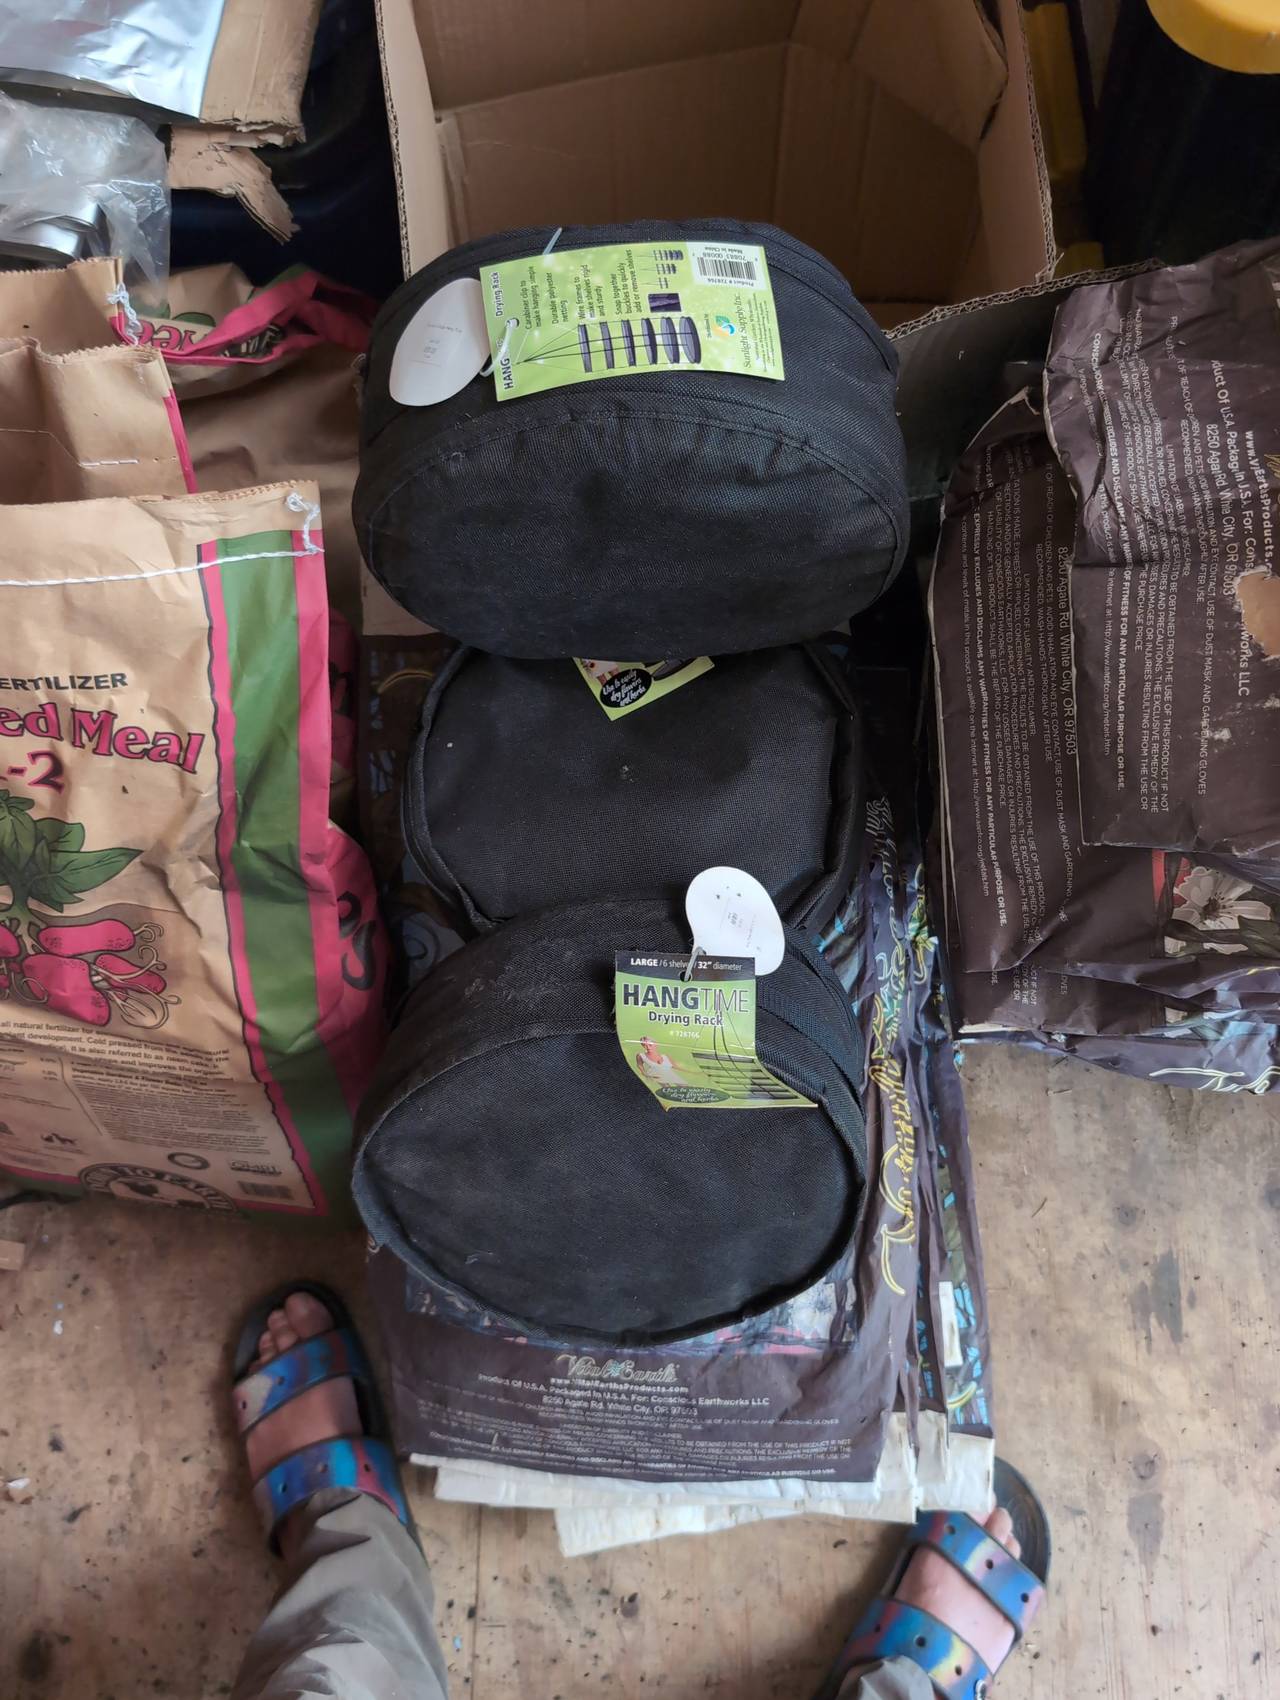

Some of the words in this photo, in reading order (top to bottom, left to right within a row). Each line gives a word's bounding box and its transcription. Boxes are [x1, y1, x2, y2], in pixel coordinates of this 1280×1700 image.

[491, 272, 500, 288] Rack
[546, 272, 556, 298] polyester
[584, 279, 593, 300] shelves
[610, 273, 620, 300] together
[494, 290, 504, 316] Drying
[521, 288, 530, 299] clip
[575, 284, 584, 304] frames
[623, 290, 632, 313] buckles
[523, 300, 532, 329] Carabiner
[550, 299, 560, 324] Durable
[560, 300, 569, 322] netting
[577, 305, 586, 320] Wire
[588, 300, 596, 318] make
[614, 301, 622, 315] Snap
[634, 302, 642, 312] add
[740, 335, 752, 368] Sunlight
[1206, 424, 1219, 448] 8250
[1207, 450, 1222, 473] Agat
[1222, 516, 1235, 541] City,
[1242, 510, 1254, 534] For:
[1226, 544, 1239, 562] OR
[974, 556, 982, 596] EXCLUDES
[1124, 570, 1131, 581] OF
[1056, 577, 1069, 608] Agate
[1170, 582, 1178, 593] BE
[1120, 582, 1130, 616] FITNESS
[1158, 592, 1166, 610] AND
[1206, 600, 1215, 616] USE
[1167, 594, 1177, 636] OBTAINED
[1206, 618, 1214, 630] OF
[976, 617, 984, 658] DISCLAIMS
[1120, 618, 1128, 636] FOR
[1060, 634, 1072, 666] White
[1166, 639, 1175, 663] FROM
[1205, 632, 1213, 655] DUST
[1165, 666, 1174, 682] THE
[1203, 657, 1212, 682] MASK
[1060, 670, 1072, 694] City,
[1117, 658, 1126, 712] PARTICULAR
[1154, 676, 1162, 693] THE
[1238, 672, 1250, 696] LLC
[978, 678, 988, 728] WARRANTIES
[1164, 685, 1172, 702] USE
[1202, 684, 1211, 703] AND
[1063, 698, 1073, 716] OR
[1152, 694, 1161, 741] EXCLUSIVE
[1163, 704, 1172, 716] OF
[982, 730, 989, 742] OF
[1064, 720, 1076, 755] 97503
[1116, 713, 1125, 754] PURPOSE
[1162, 718, 1171, 737] THIS
[70, 708, 205, 775] Meal
[983, 743, 991, 775] FITNESS
[1117, 756, 1124, 769] OR
[1150, 743, 1159, 779] REMEDY
[1161, 739, 1170, 781] PRODUCT
[1150, 781, 1158, 793] OF
[1161, 782, 1169, 792] IF
[1198, 760, 1207, 795] GLOVES
[1150, 796, 1158, 813] THE
[1160, 794, 1169, 812] NOT
[988, 812, 997, 860] PARTICULAR
[998, 897, 1005, 908] OR
[630, 958, 658, 967] LARGE
[663, 959, 668, 967] 6
[713, 962, 742, 971] diameter
[623, 984, 749, 1012] HANGTIME
[13, 1022, 43, 1030] natural
[46, 1024, 79, 1032] fertilizer
[649, 1012, 690, 1026] Drying
[695, 1014, 723, 1026] Rack
[108, 1048, 142, 1058] referred
[698, 1397, 749, 1407] Earthworks
[751, 1398, 770, 1406] LLC
